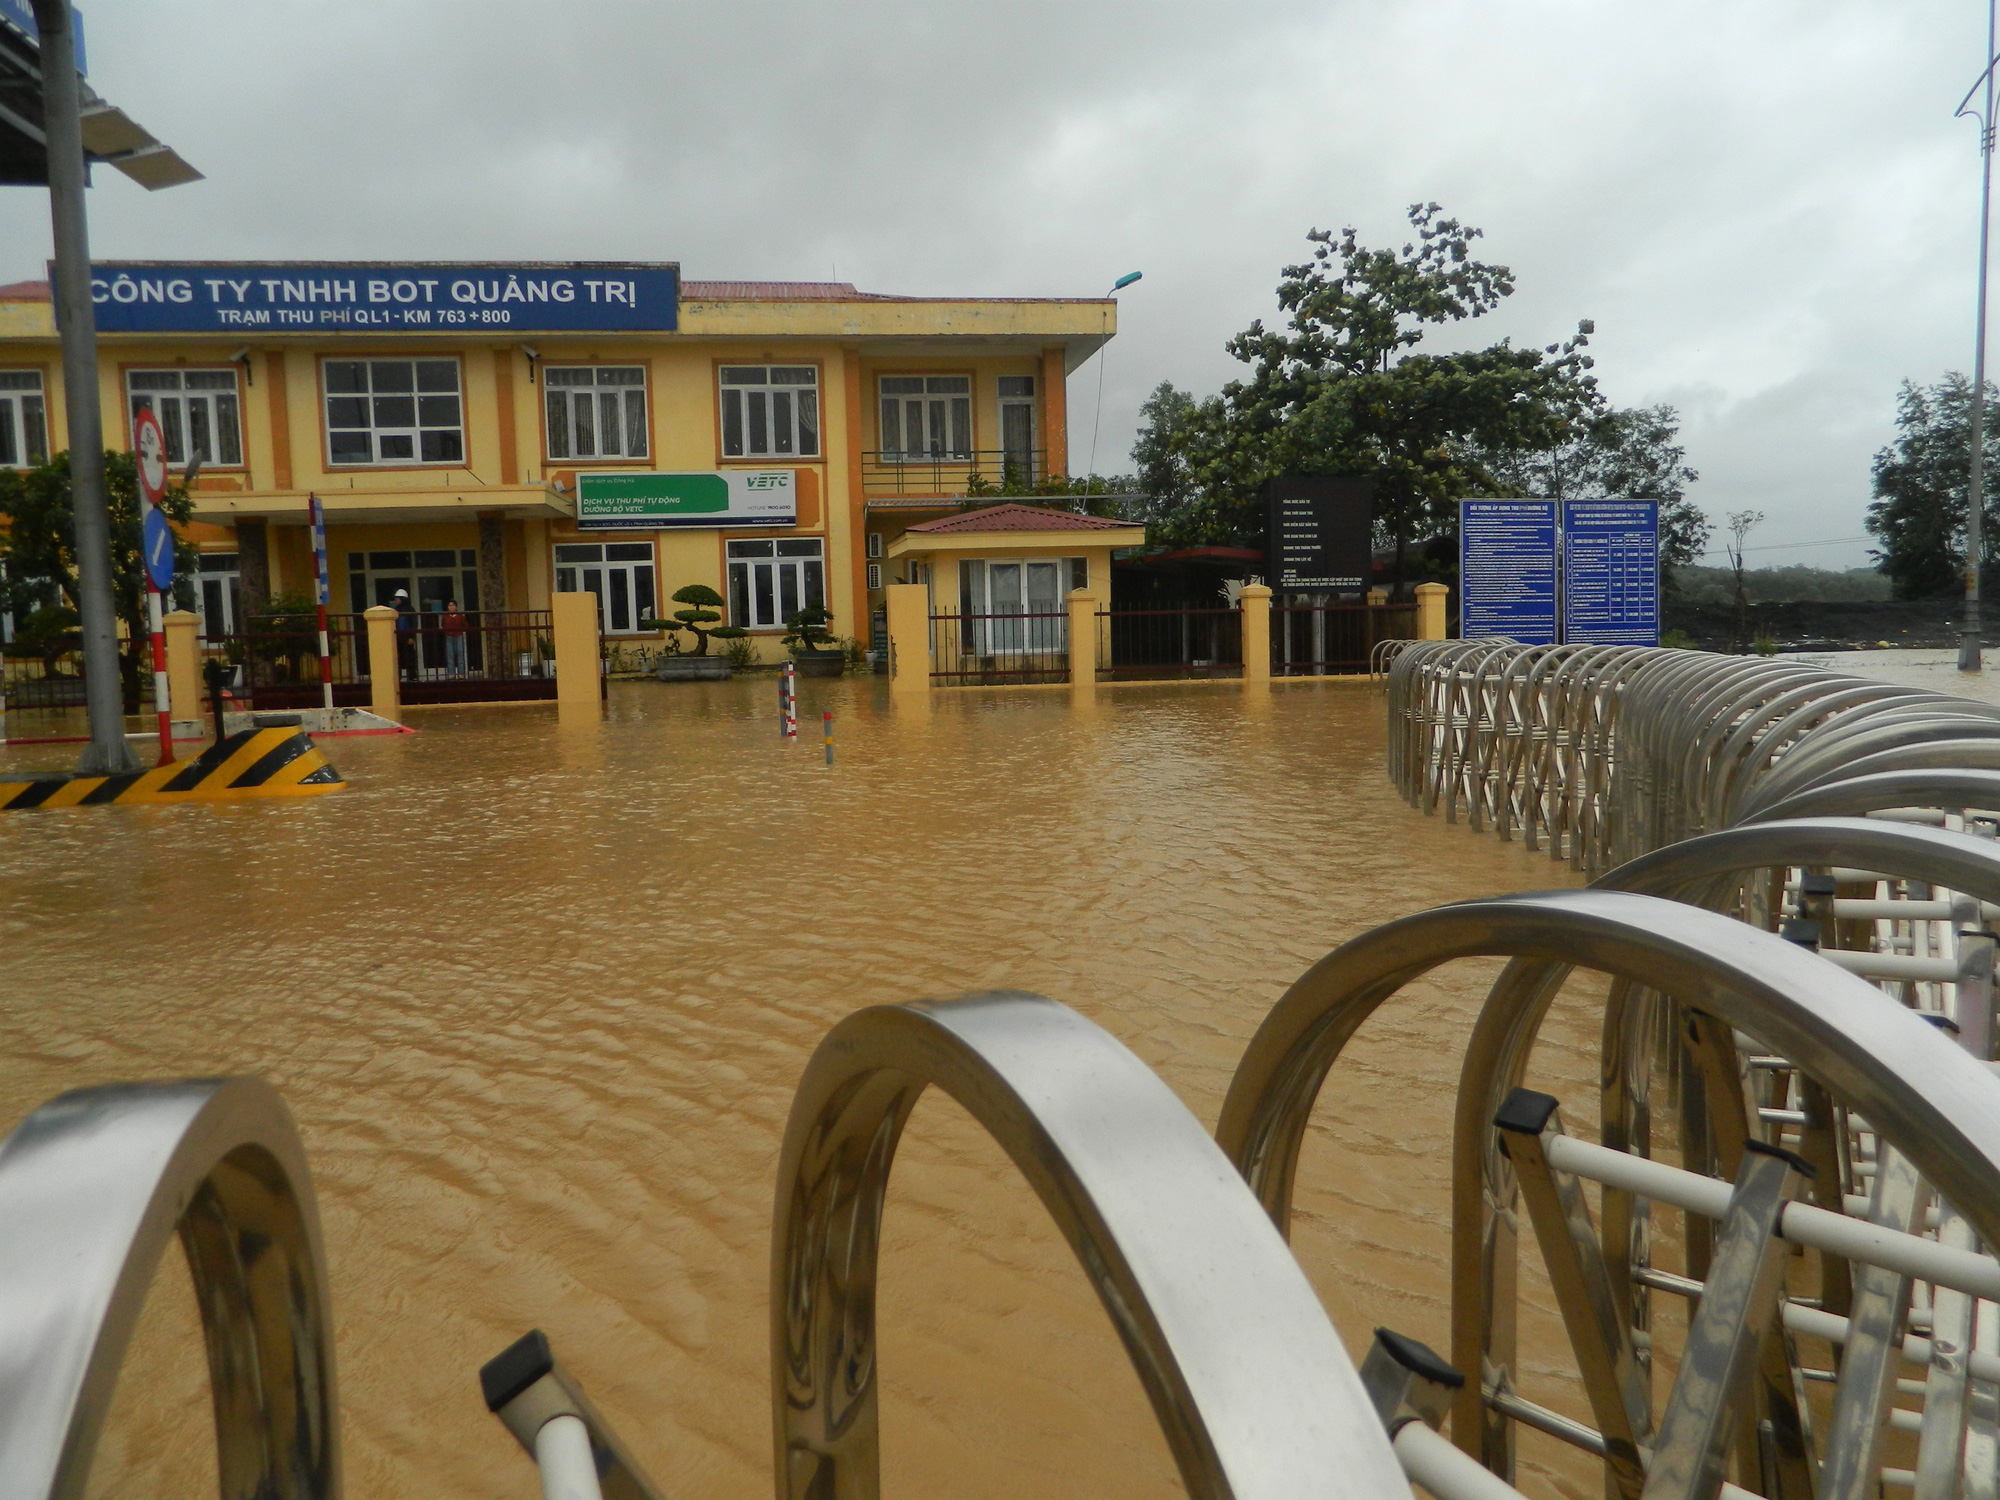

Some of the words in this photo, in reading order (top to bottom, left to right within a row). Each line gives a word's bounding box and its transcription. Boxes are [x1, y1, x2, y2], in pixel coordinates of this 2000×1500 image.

[91, 273, 193, 303] CÔNG
[204, 279, 252, 303] TY
[260, 279, 356, 303] TNHH
[368, 280, 439, 303] BOT
[451, 274, 575, 305] QUẢNG
[583, 280, 636, 308] TRỊ
[217, 309, 270, 326] TRẠM
[277, 309, 314, 323] THU
[320, 306, 351, 323] PHÍ
[747, 476, 788, 488] VETC
[583, 498, 602, 506] DỊCH
[604, 497, 615, 506] VỤ
[632, 495, 647, 504] PHÍ
[658, 495, 680, 505] ĐỘNG
[612, 504, 624, 514] BỘ
